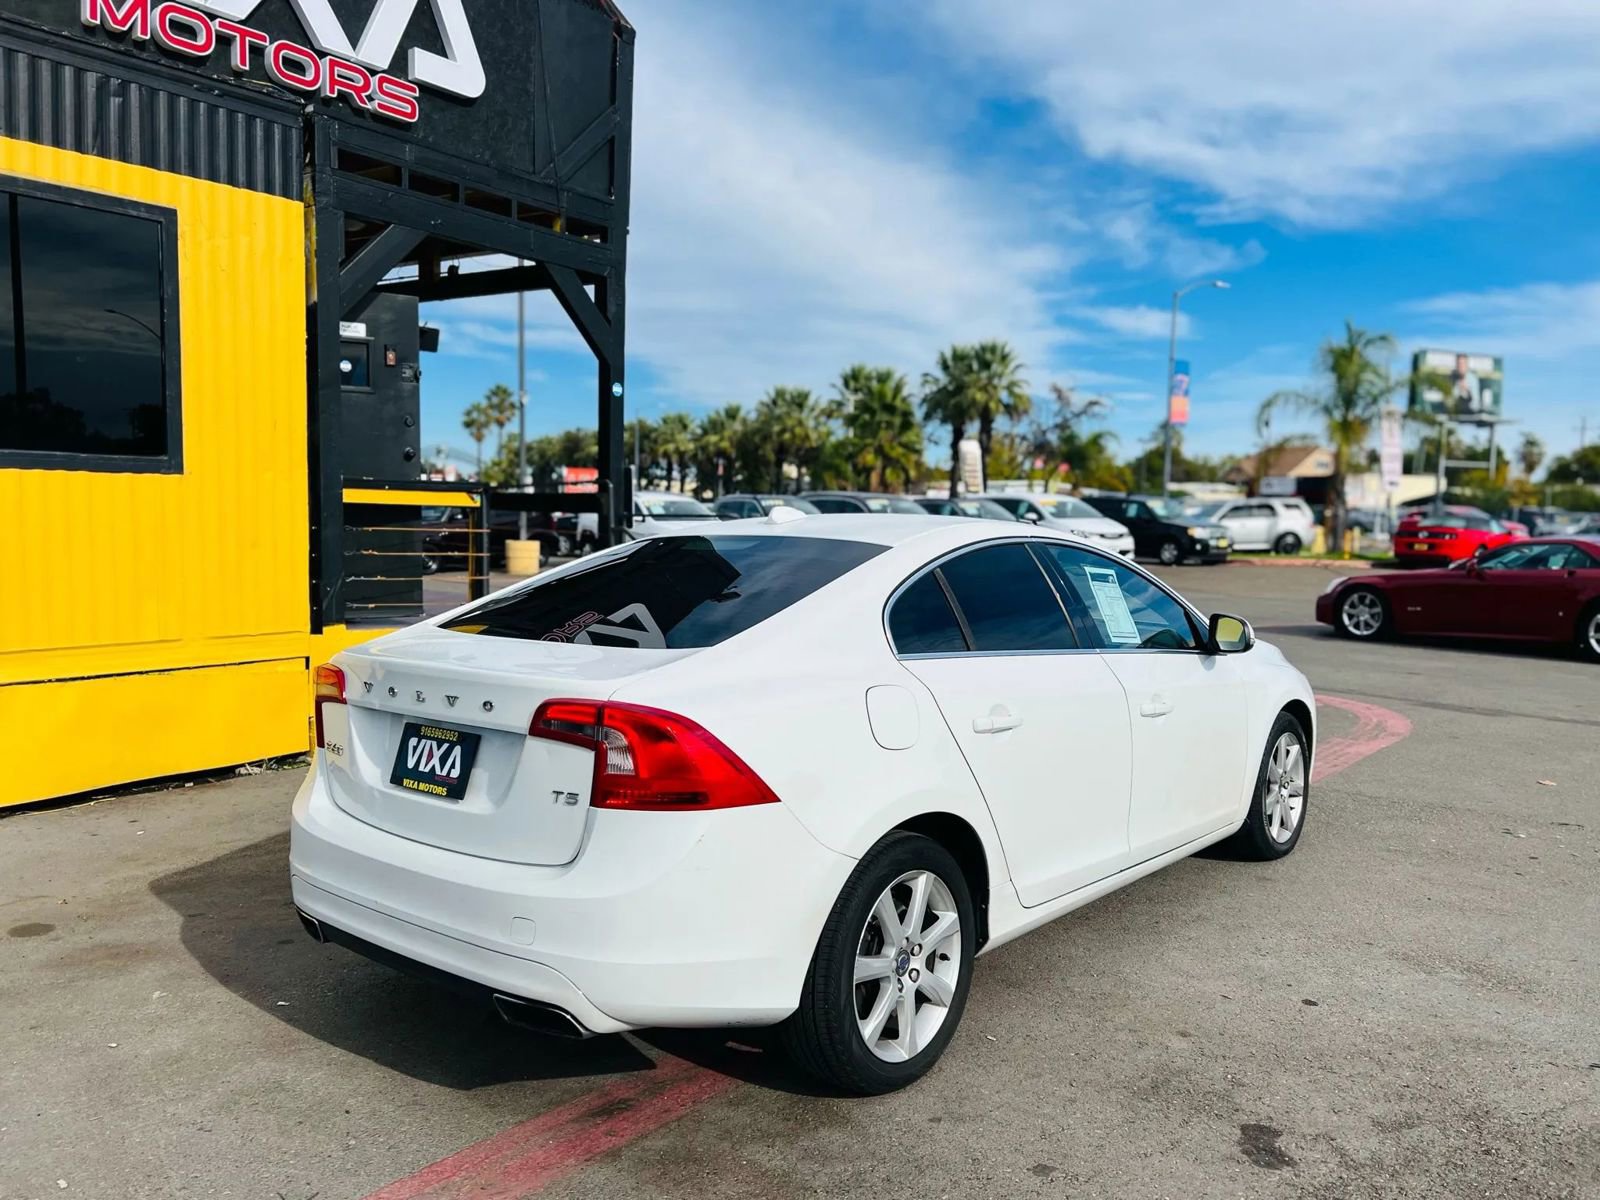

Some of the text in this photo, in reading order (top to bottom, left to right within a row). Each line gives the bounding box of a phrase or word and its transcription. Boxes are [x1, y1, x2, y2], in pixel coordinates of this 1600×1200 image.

[81, 0, 419, 123] MOTORS
[364, 681, 494, 712] VOLVO
[407, 737, 461, 778] VIXA
[403, 779, 447, 795] VIXA MOTORS
[552, 790, 579, 806] T5
